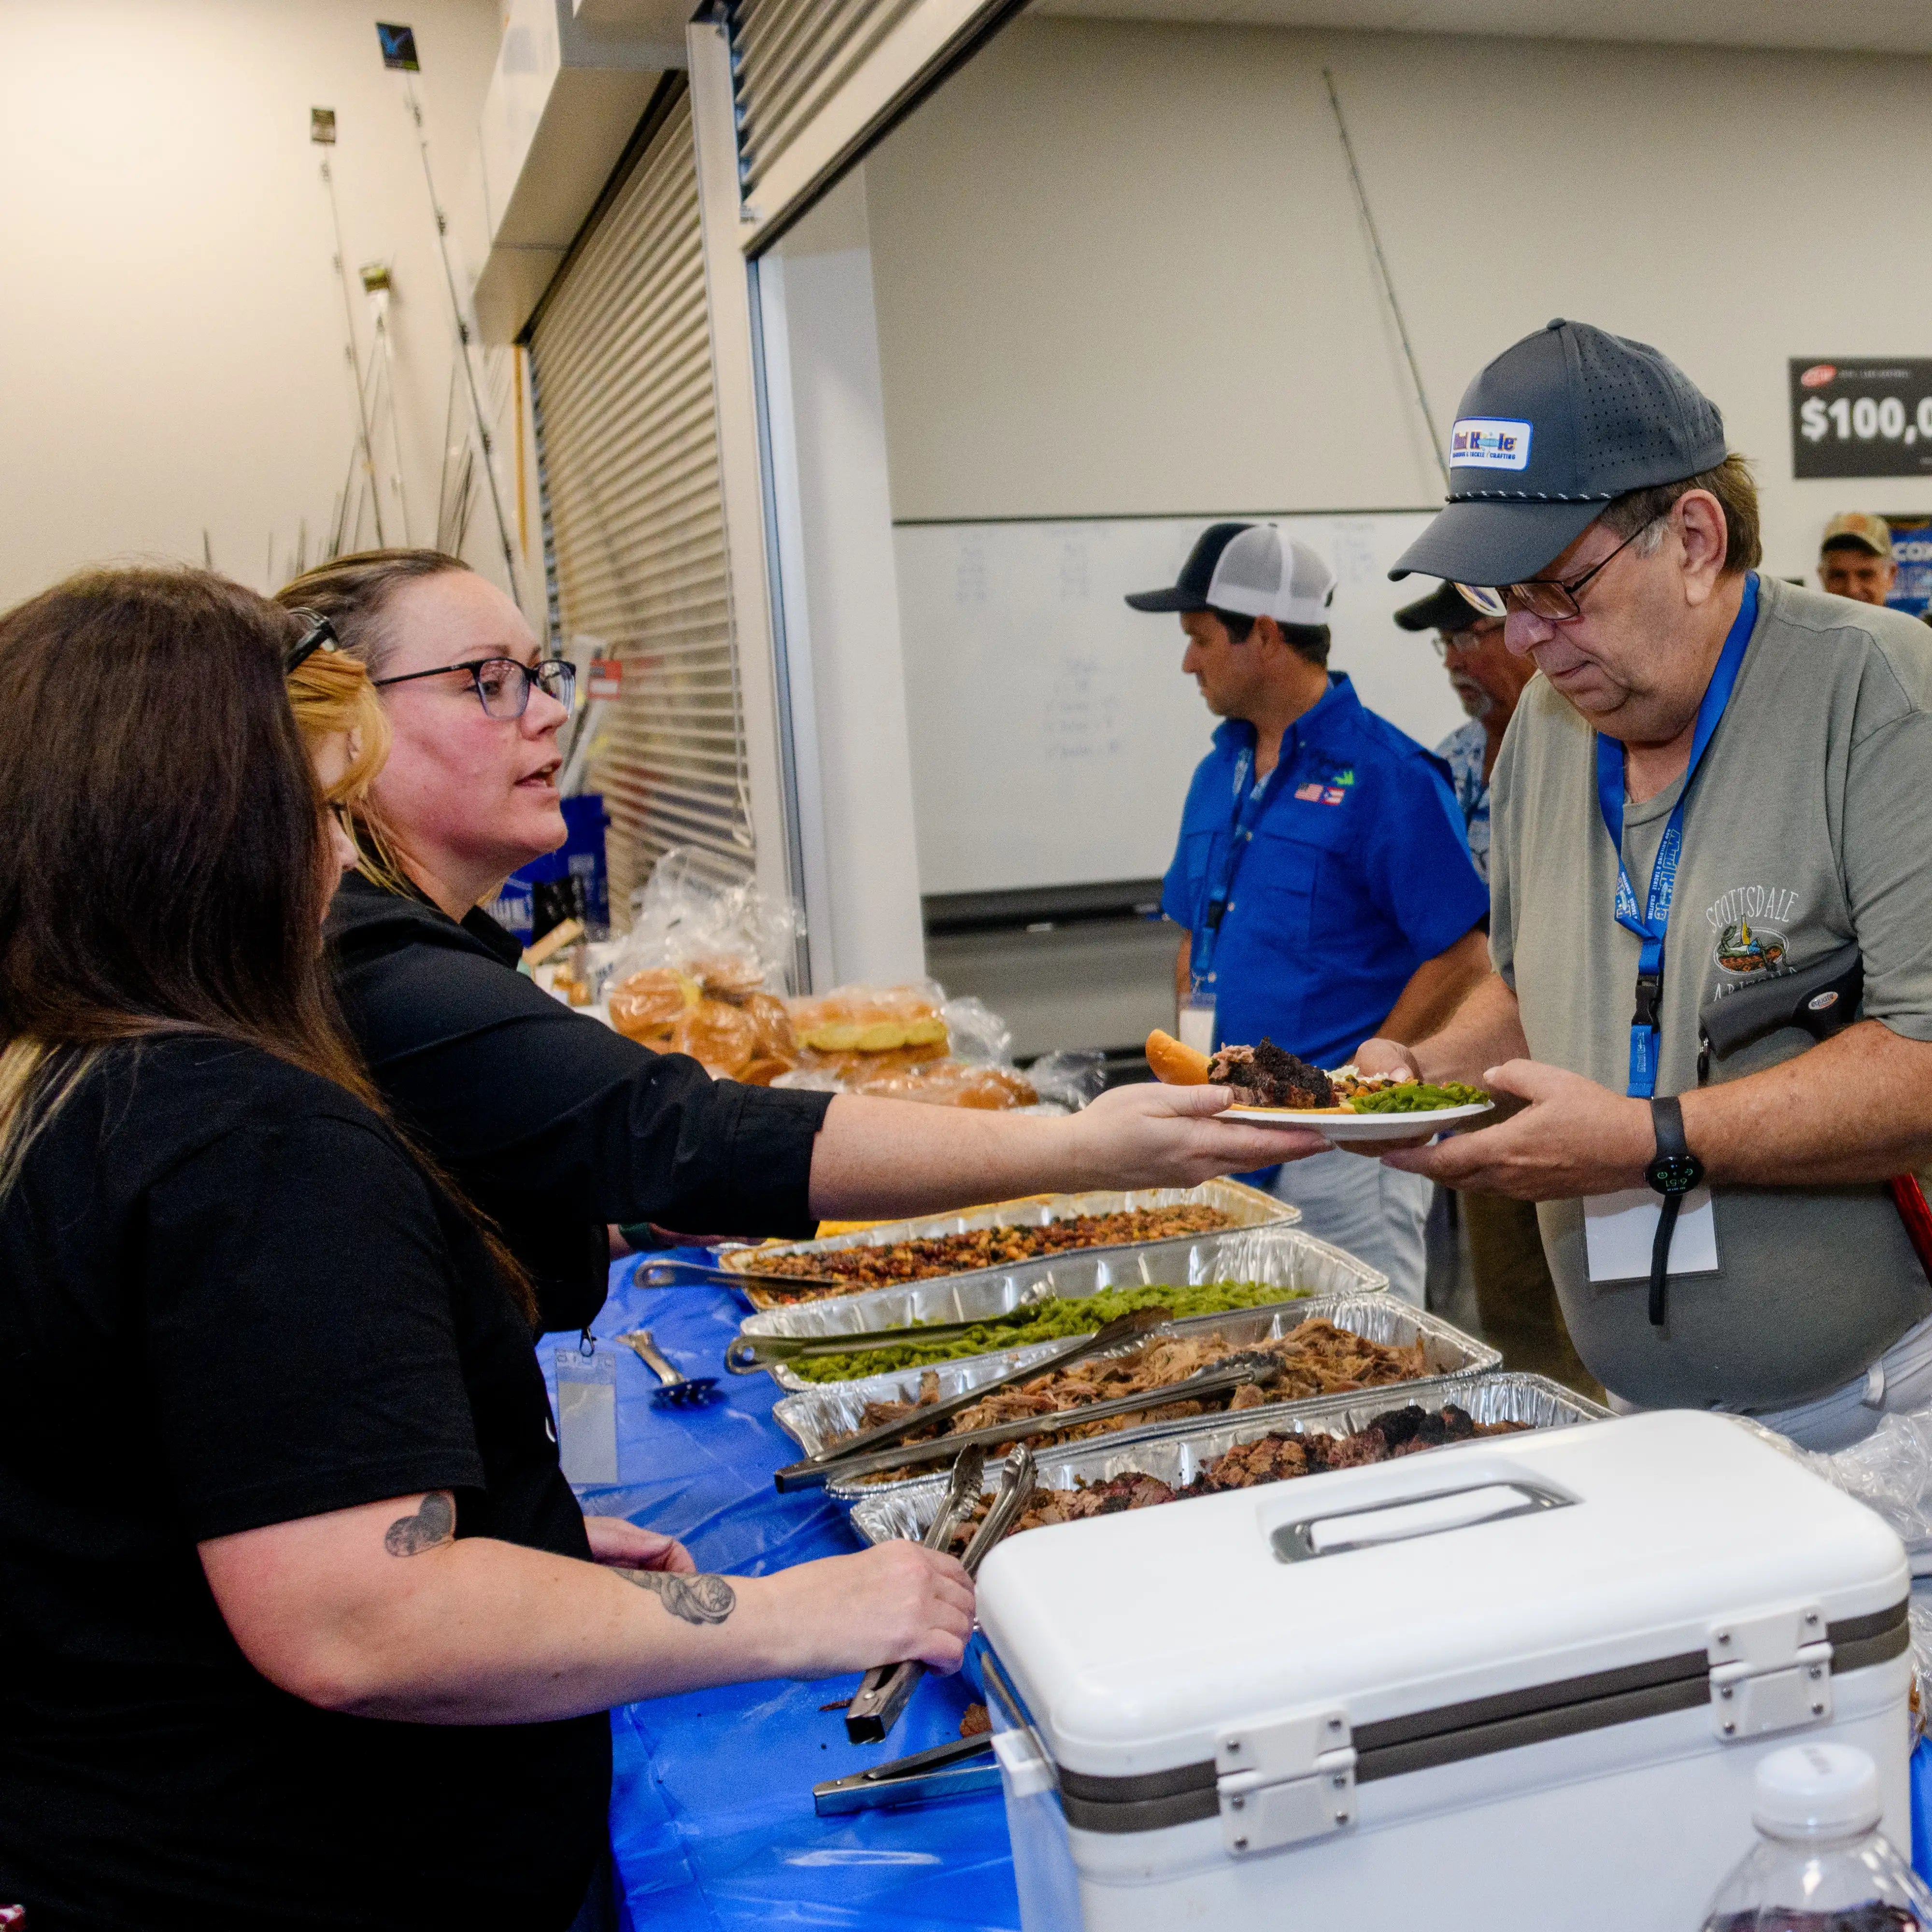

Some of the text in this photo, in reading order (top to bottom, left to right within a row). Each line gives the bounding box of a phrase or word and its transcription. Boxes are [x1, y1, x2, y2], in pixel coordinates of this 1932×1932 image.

[1470, 431, 1516, 451] Hle
[1658, 840, 1667, 865] BUILDING
[1652, 872, 1660, 890] TACKLE
[1654, 871, 1676, 920] Hle
[1648, 895, 1656, 920] CRAFTING
[1706, 885, 1798, 933] SCOTTSDALE
[1811, 993, 1833, 1007] equate
[1666, 1178, 1687, 1187] 6:51
